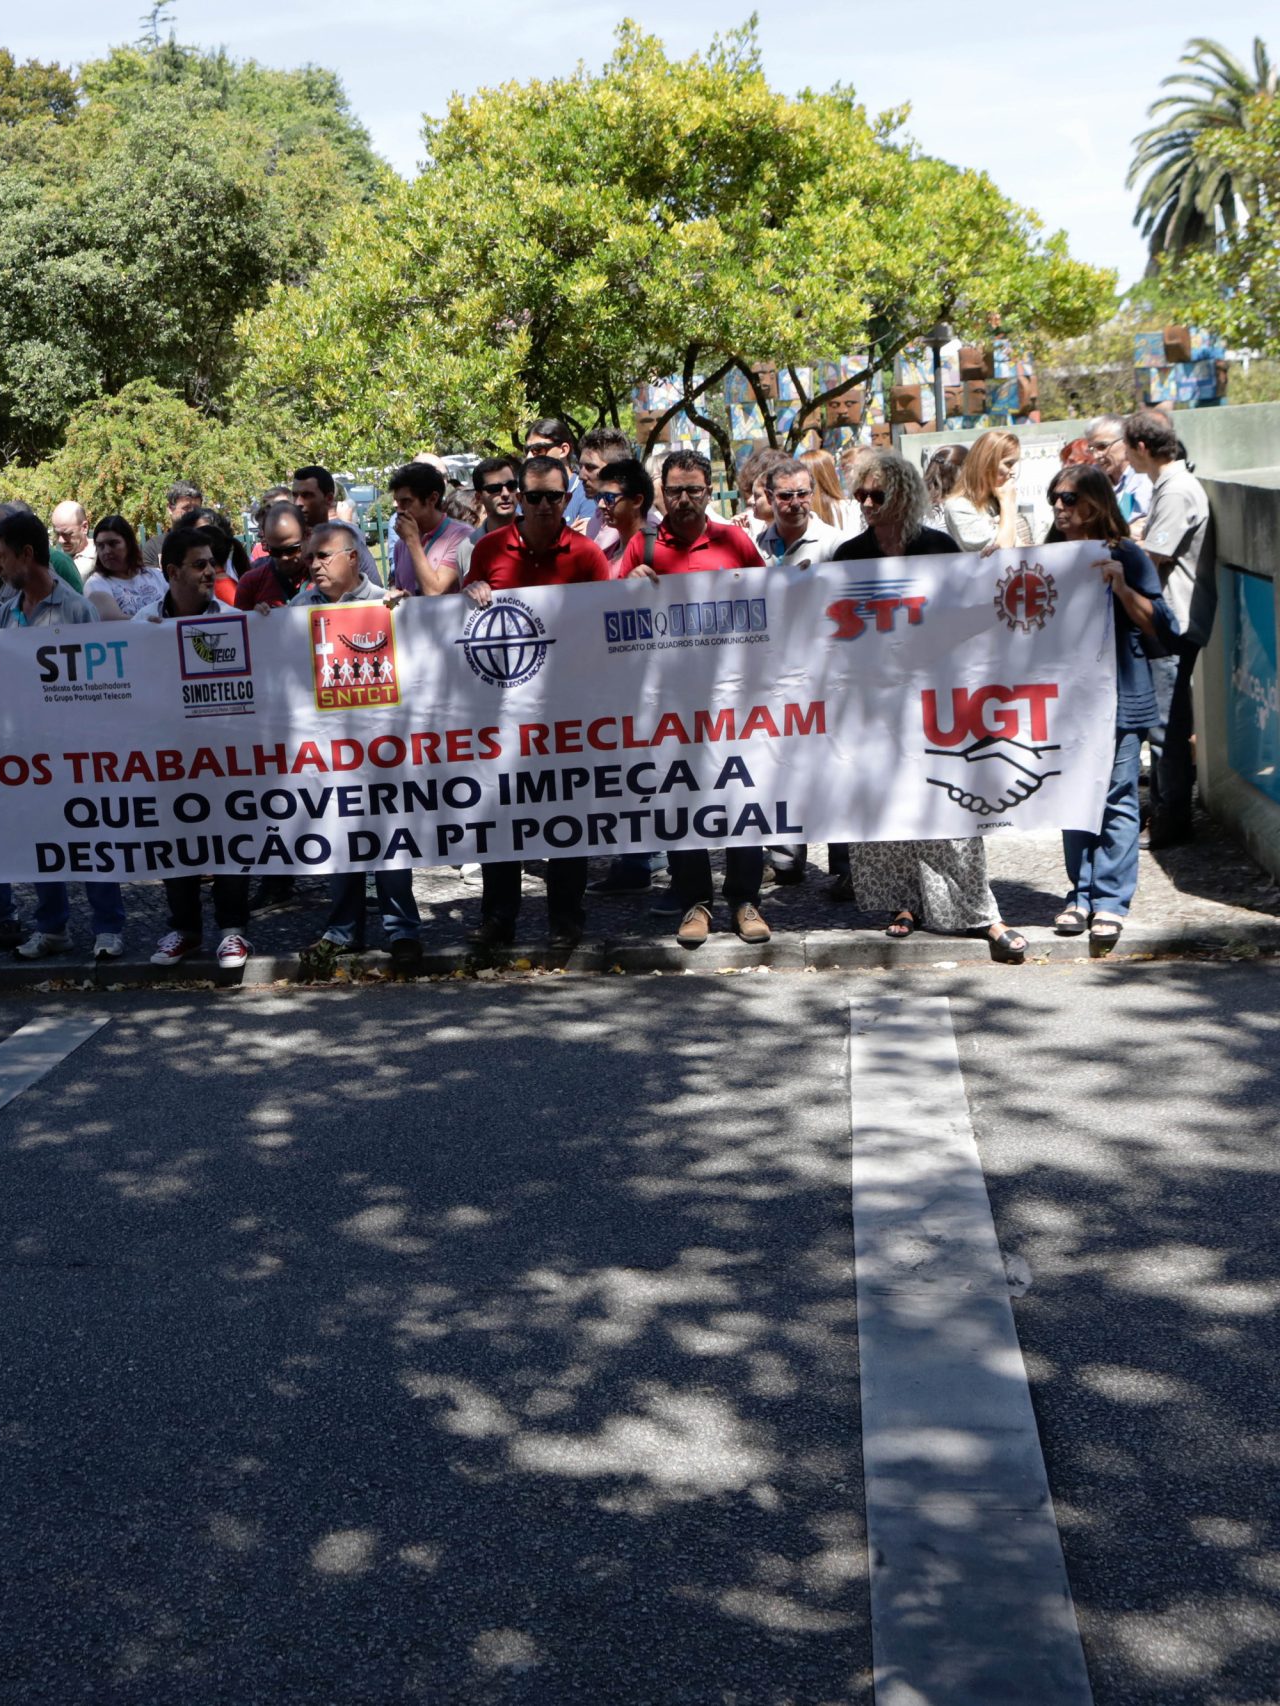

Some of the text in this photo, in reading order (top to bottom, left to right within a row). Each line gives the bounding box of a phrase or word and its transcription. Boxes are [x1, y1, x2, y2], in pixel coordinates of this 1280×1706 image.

[496, 597, 533, 616] NACIONAL
[534, 617, 546, 635] DOS
[604, 599, 767, 642] SINQUADROS
[826, 596, 927, 641] STT
[36, 641, 128, 683] STPT
[463, 641, 547, 688] QUADROS DAS TELECOMUNICAÇÕES
[608, 645, 645, 654] SINDICATO
[657, 640, 693, 649] QUADROS
[711, 634, 769, 645] COMUNICAÇÕES
[42, 685, 71, 693] Sindicato
[84, 682, 131, 690] Trabalhadores
[45, 692, 132, 703] do Grupo Portugal Telecom
[182, 680, 254, 704] SINDETELCO
[321, 686, 395, 706] SNTCT
[921, 683, 1059, 747] UGT
[63, 727, 502, 783] TRABALHADORES
[519, 700, 827, 757] RECLAMAM
[64, 756, 755, 828] QUE O GOVERNO IMPEÇA A
[35, 801, 803, 873] DESTRUIÇÃO DA PT PORTUGAL
[977, 821, 1014, 830] PORTUGAL
